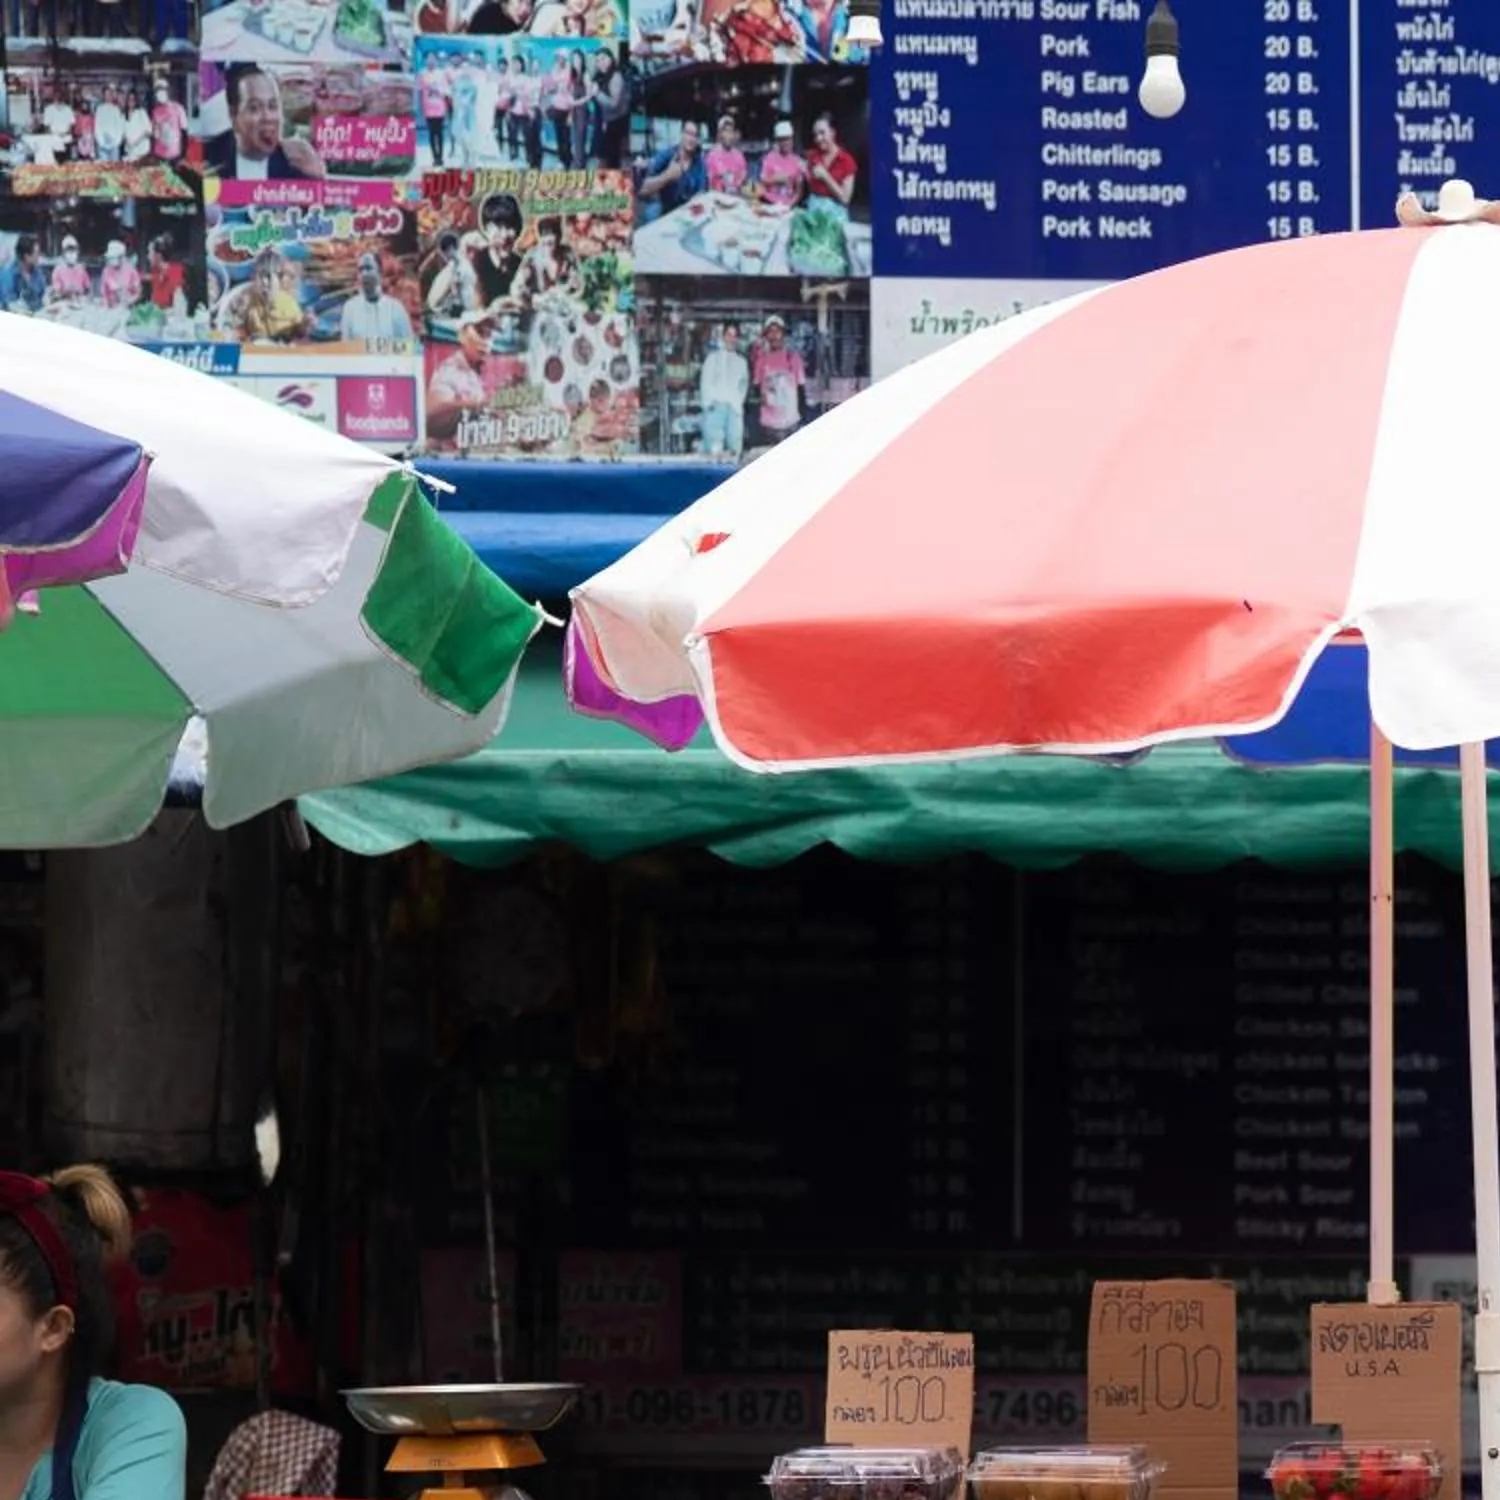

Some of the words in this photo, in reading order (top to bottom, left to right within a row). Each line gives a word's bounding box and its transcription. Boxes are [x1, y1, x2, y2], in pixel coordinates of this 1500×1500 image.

[1041, 0, 1088, 20] Sour
[1097, 0, 1140, 21] Fish
[1265, 1, 1289, 21] 20
[1298, 1, 1319, 21] B.
[1041, 36, 1089, 56] Pork
[1265, 37, 1289, 57] 20
[1298, 37, 1319, 57] B.
[1041, 72, 1075, 97] Pig
[1083, 73, 1129, 94] Ears
[1265, 74, 1289, 95] 20
[1298, 74, 1319, 95] B.
[1041, 108, 1128, 130] Roasted
[1267, 110, 1289, 131] 15
[1298, 110, 1319, 131] B.
[1042, 144, 1162, 168] Chitterlings
[1267, 146, 1289, 167] 15
[1298, 146, 1319, 167] B.
[1042, 181, 1090, 202] Pork
[1098, 181, 1187, 206] Sausage
[1267, 182, 1289, 203] 15
[1298, 182, 1319, 203] B.
[1043, 217, 1091, 238] Pork
[1099, 217, 1152, 238] Neck
[1267, 218, 1289, 237] 15
[1298, 218, 1319, 237] B.
[345, 412, 410, 433] foodpanda
[577, 1387, 804, 1426] 1-096-1878
